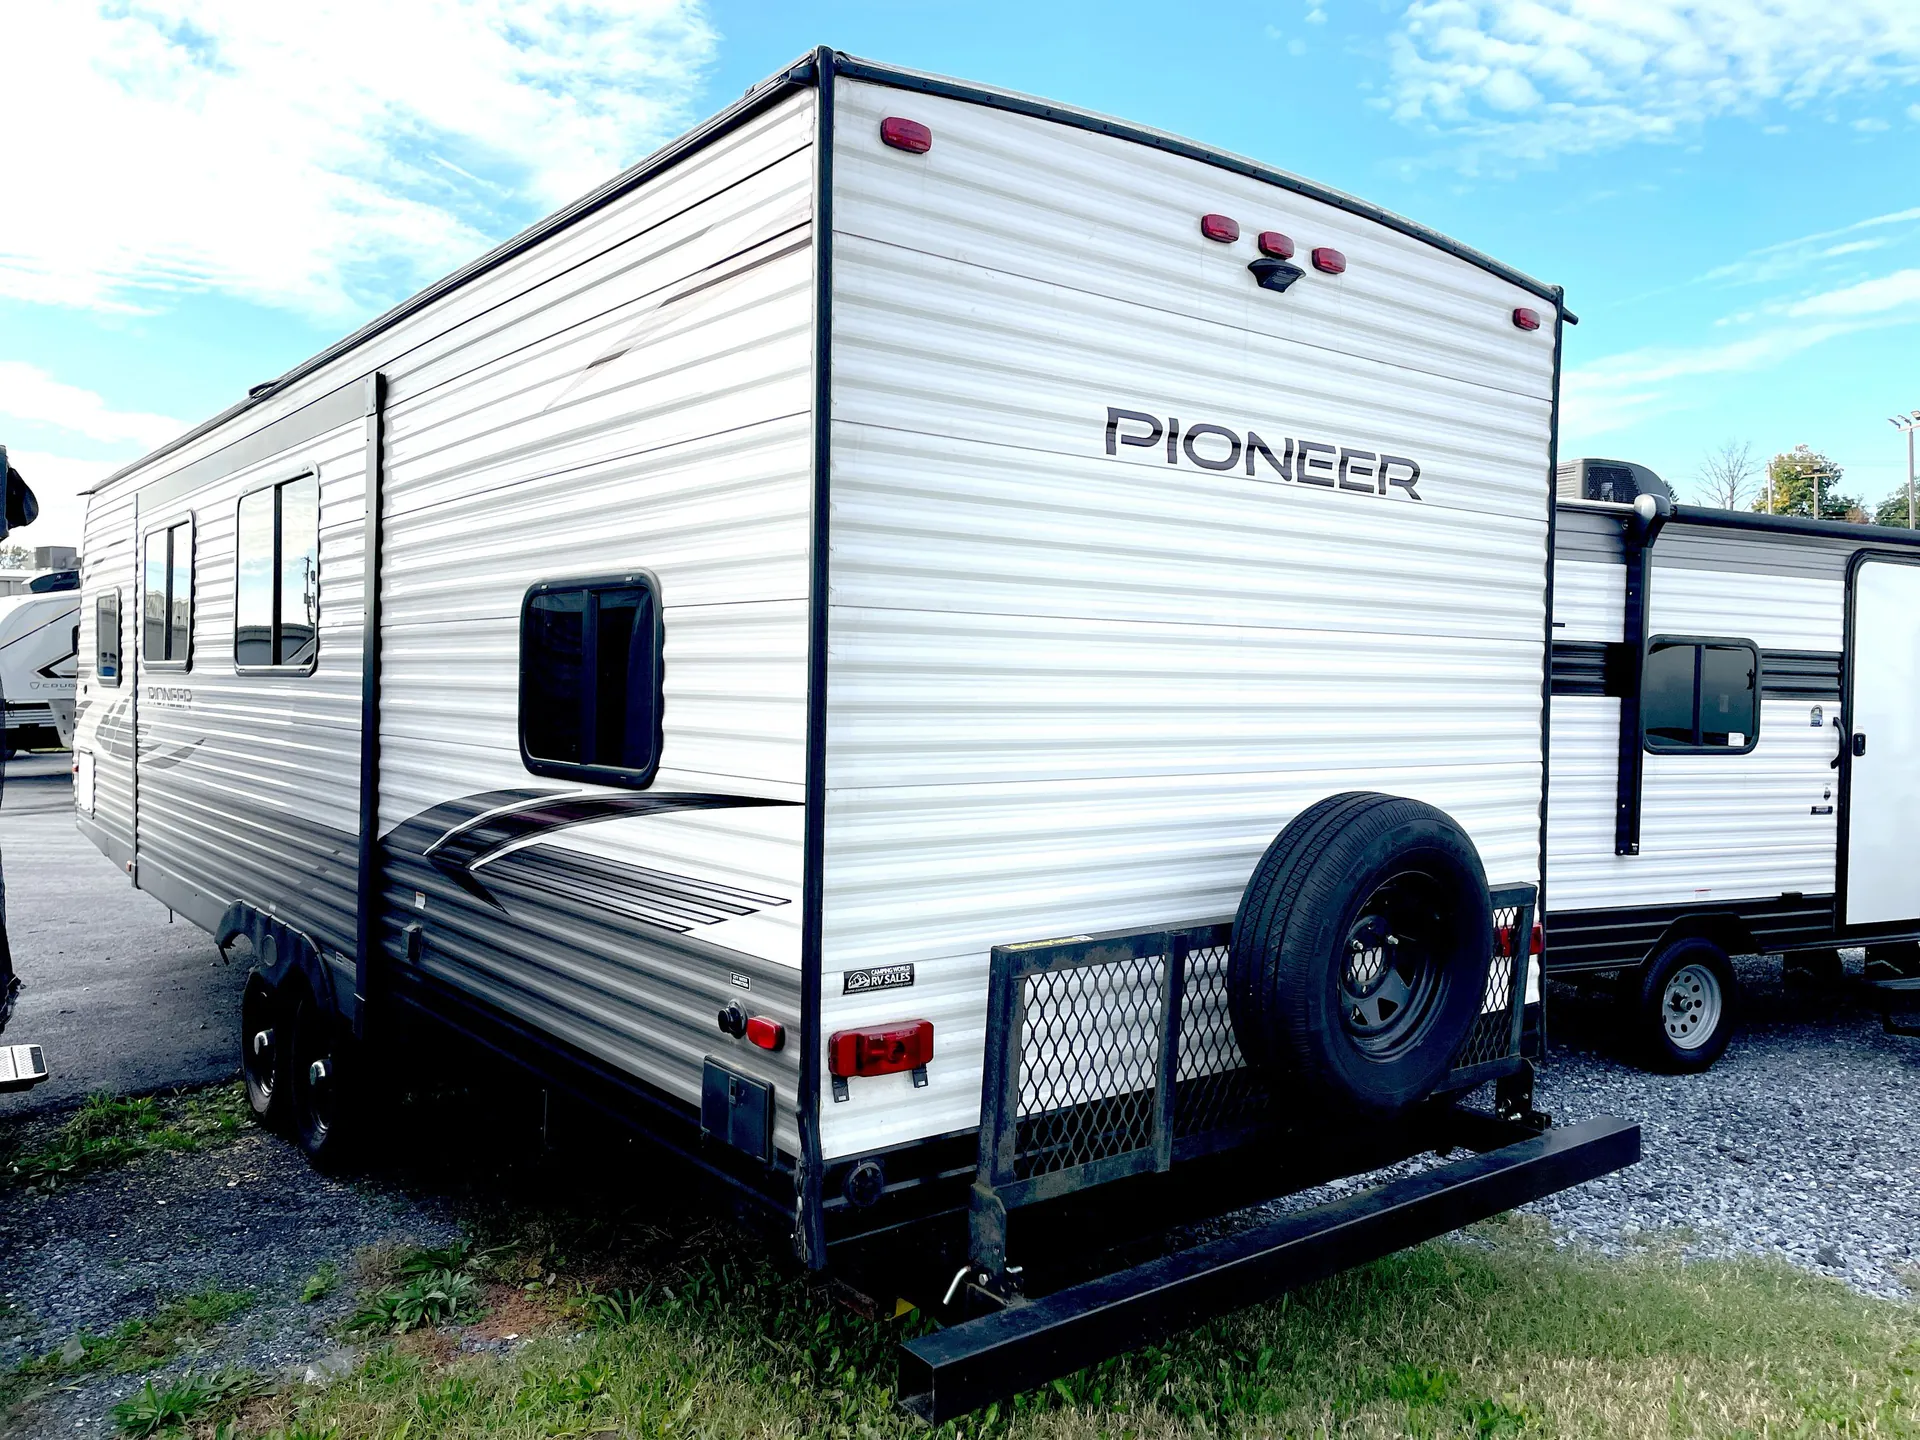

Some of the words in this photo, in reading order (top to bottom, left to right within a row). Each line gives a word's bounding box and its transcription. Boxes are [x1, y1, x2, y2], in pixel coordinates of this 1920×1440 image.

[1106, 407, 1422, 500] PIONEER
[871, 968, 892, 976] CAMPING
[892, 965, 911, 973] WORLD
[871, 975, 884, 986] RV
[884, 972, 911, 985] SALES
